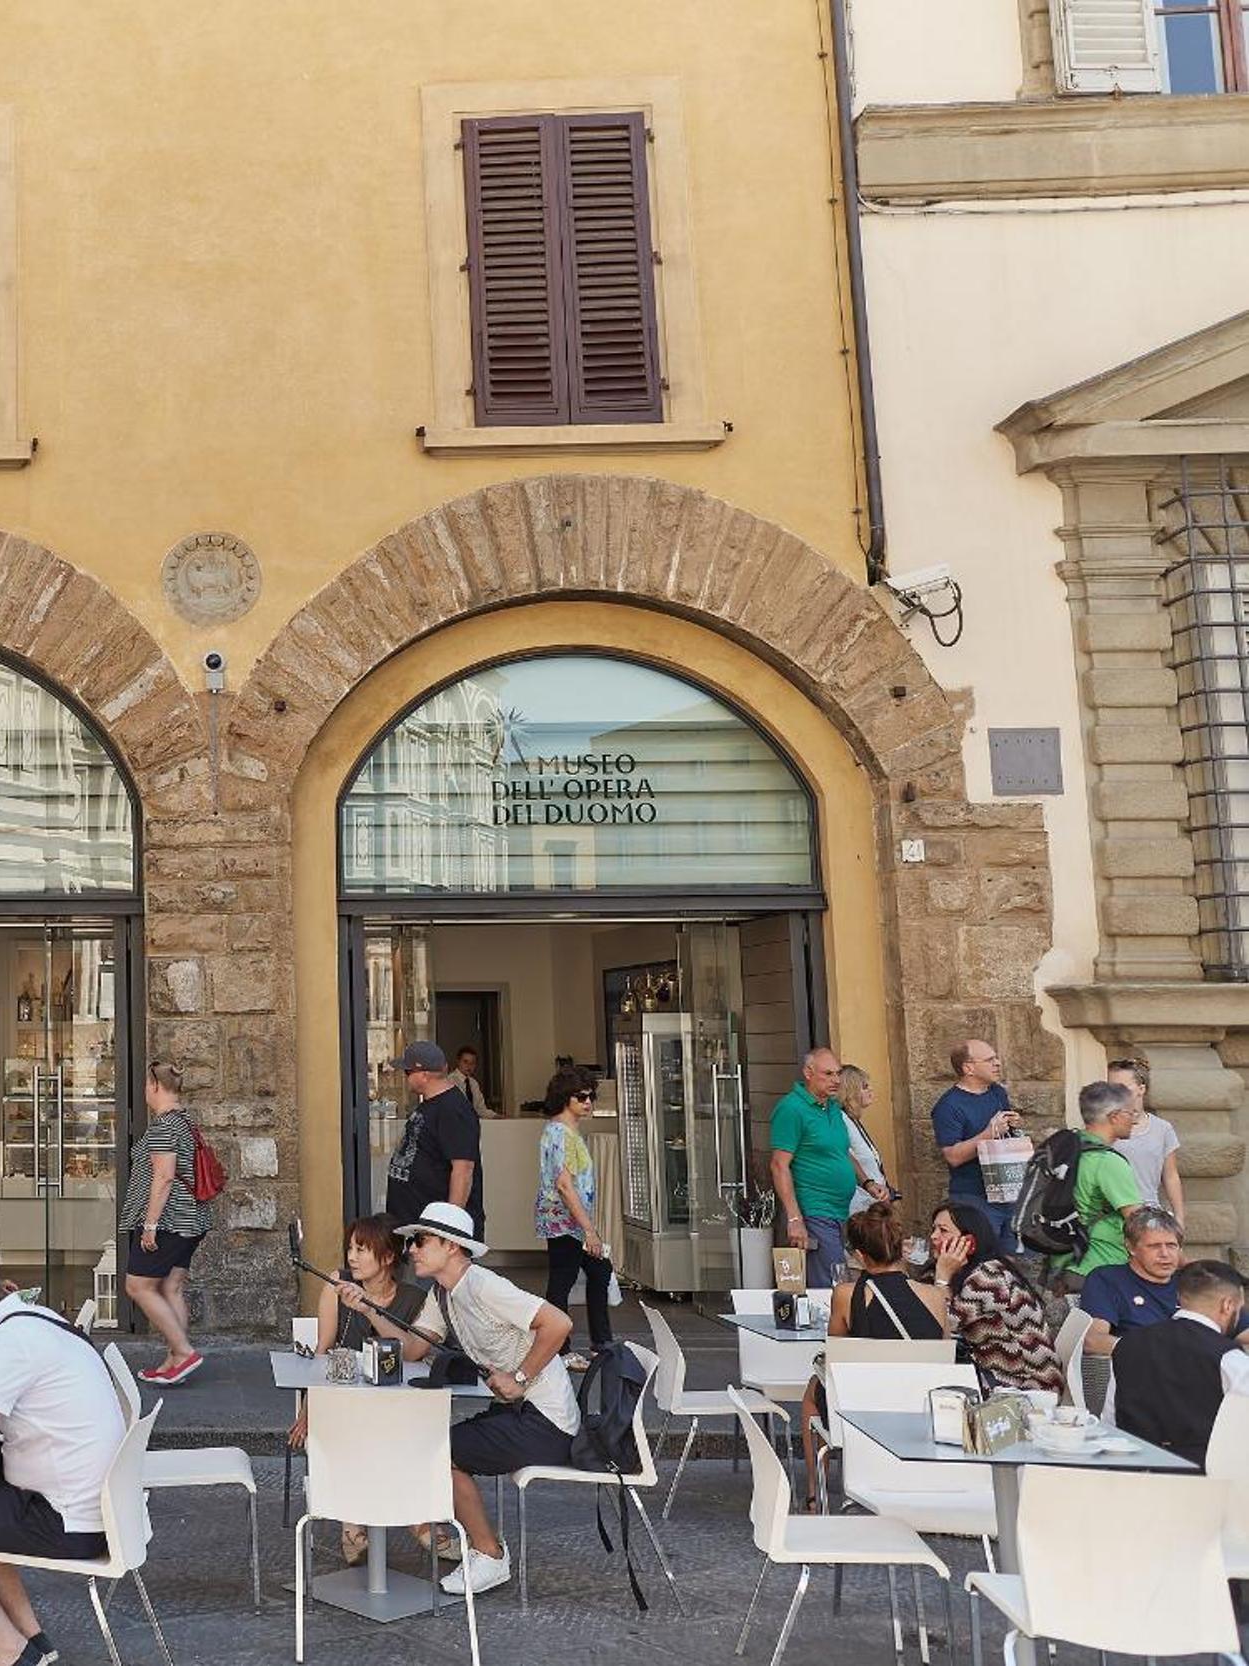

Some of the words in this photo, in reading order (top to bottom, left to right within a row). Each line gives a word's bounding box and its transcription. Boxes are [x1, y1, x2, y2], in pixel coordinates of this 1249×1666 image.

[537, 754, 636, 775] MUSEO
[491, 779, 554, 801] DELL'
[563, 779, 655, 800] OPERA
[492, 804, 538, 826] DEL
[545, 803, 657, 825] DUOMO
